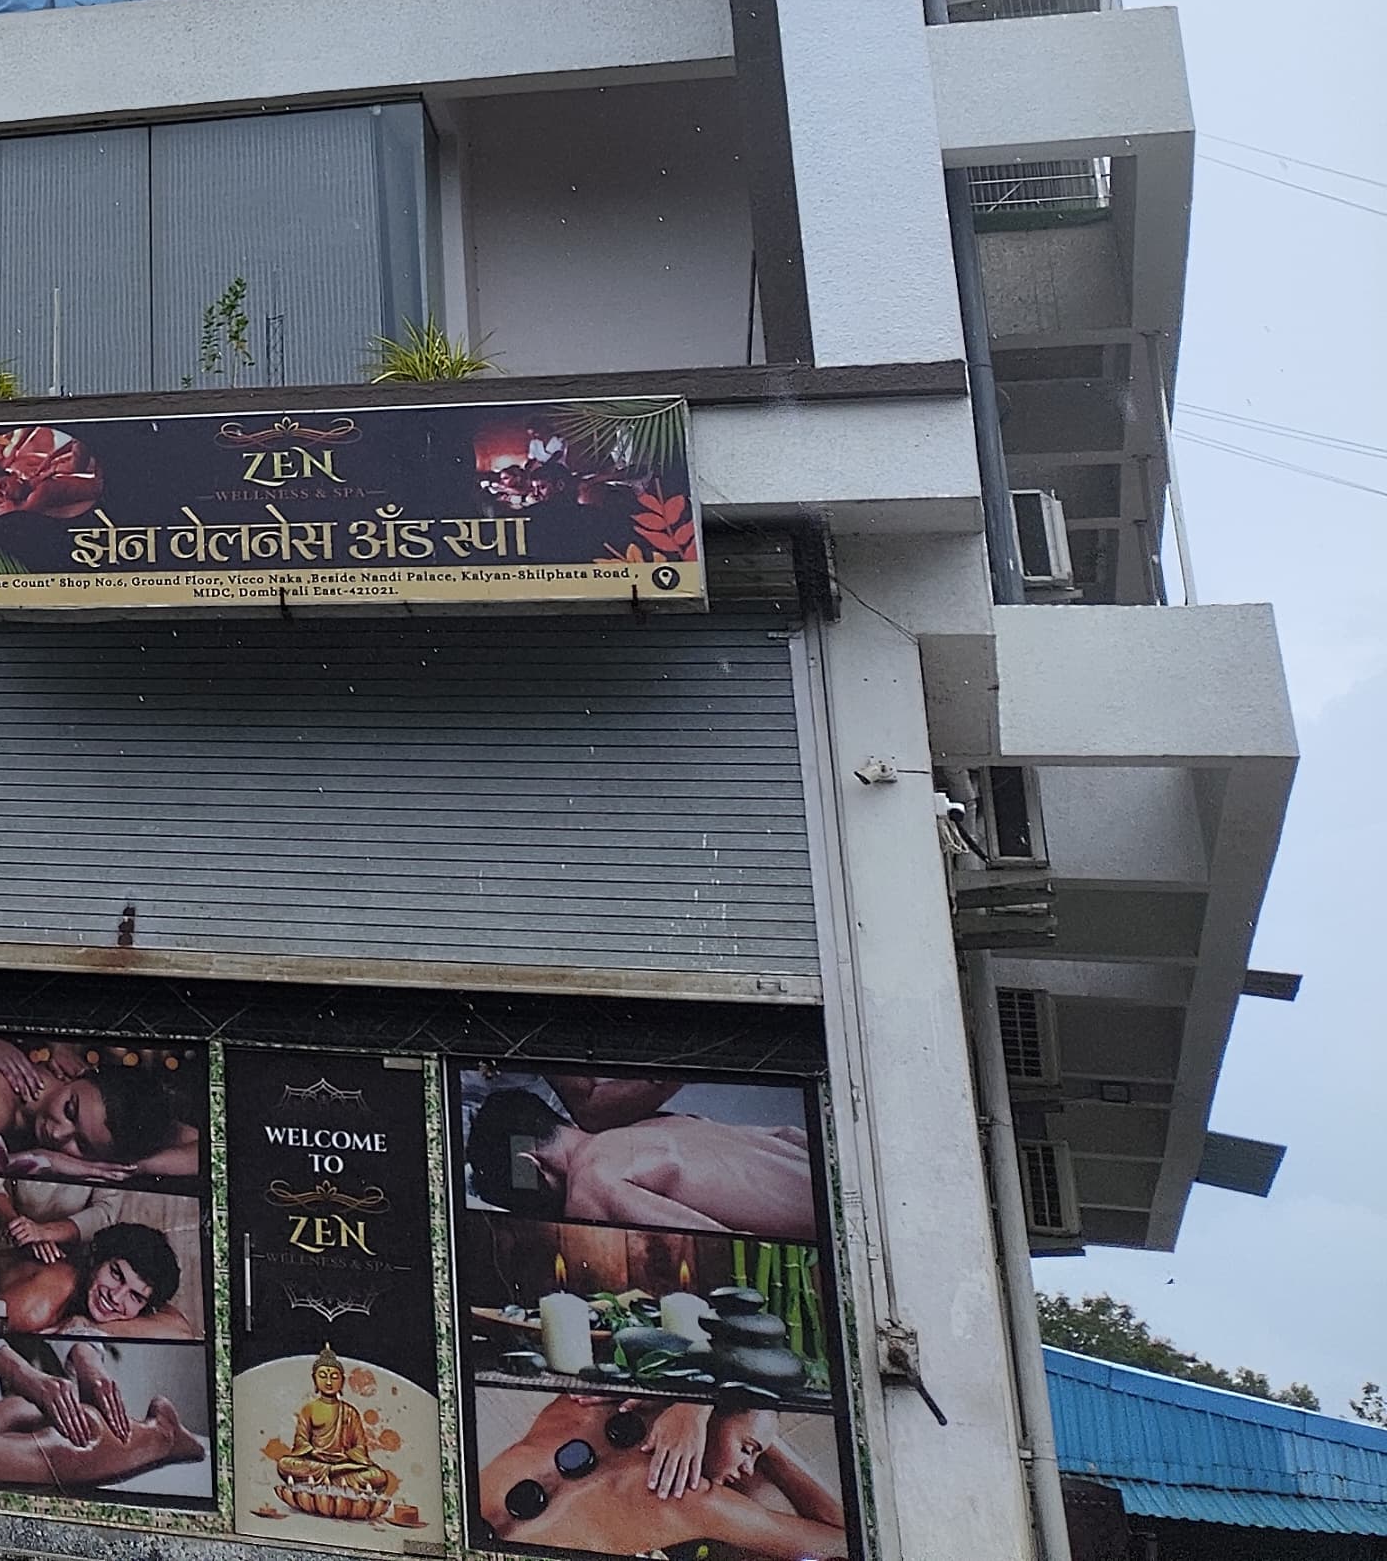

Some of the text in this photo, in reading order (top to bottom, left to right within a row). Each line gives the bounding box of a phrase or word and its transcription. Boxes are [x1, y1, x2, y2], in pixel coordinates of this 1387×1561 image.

[242, 446, 348, 487] ZEN
[215, 489, 309, 502] WELLNESS
[333, 487, 366, 498] SPA
[68, 509, 161, 568] झेन
[167, 504, 337, 563] वेलनेस
[441, 516, 531, 559] स्पा
[59, 577, 91, 590] Shop
[131, 575, 181, 587] Ground
[185, 575, 223, 587] Floor,
[227, 574, 264, 585] Vicco
[269, 574, 302, 584] Naka
[360, 572, 402, 582] Nandi
[406, 571, 457, 583] Palace,
[193, 588, 235, 600] MIDC,
[264, 1125, 388, 1153] WELCOME
[308, 1153, 345, 1174] TO
[288, 1214, 378, 1256] ZEN
